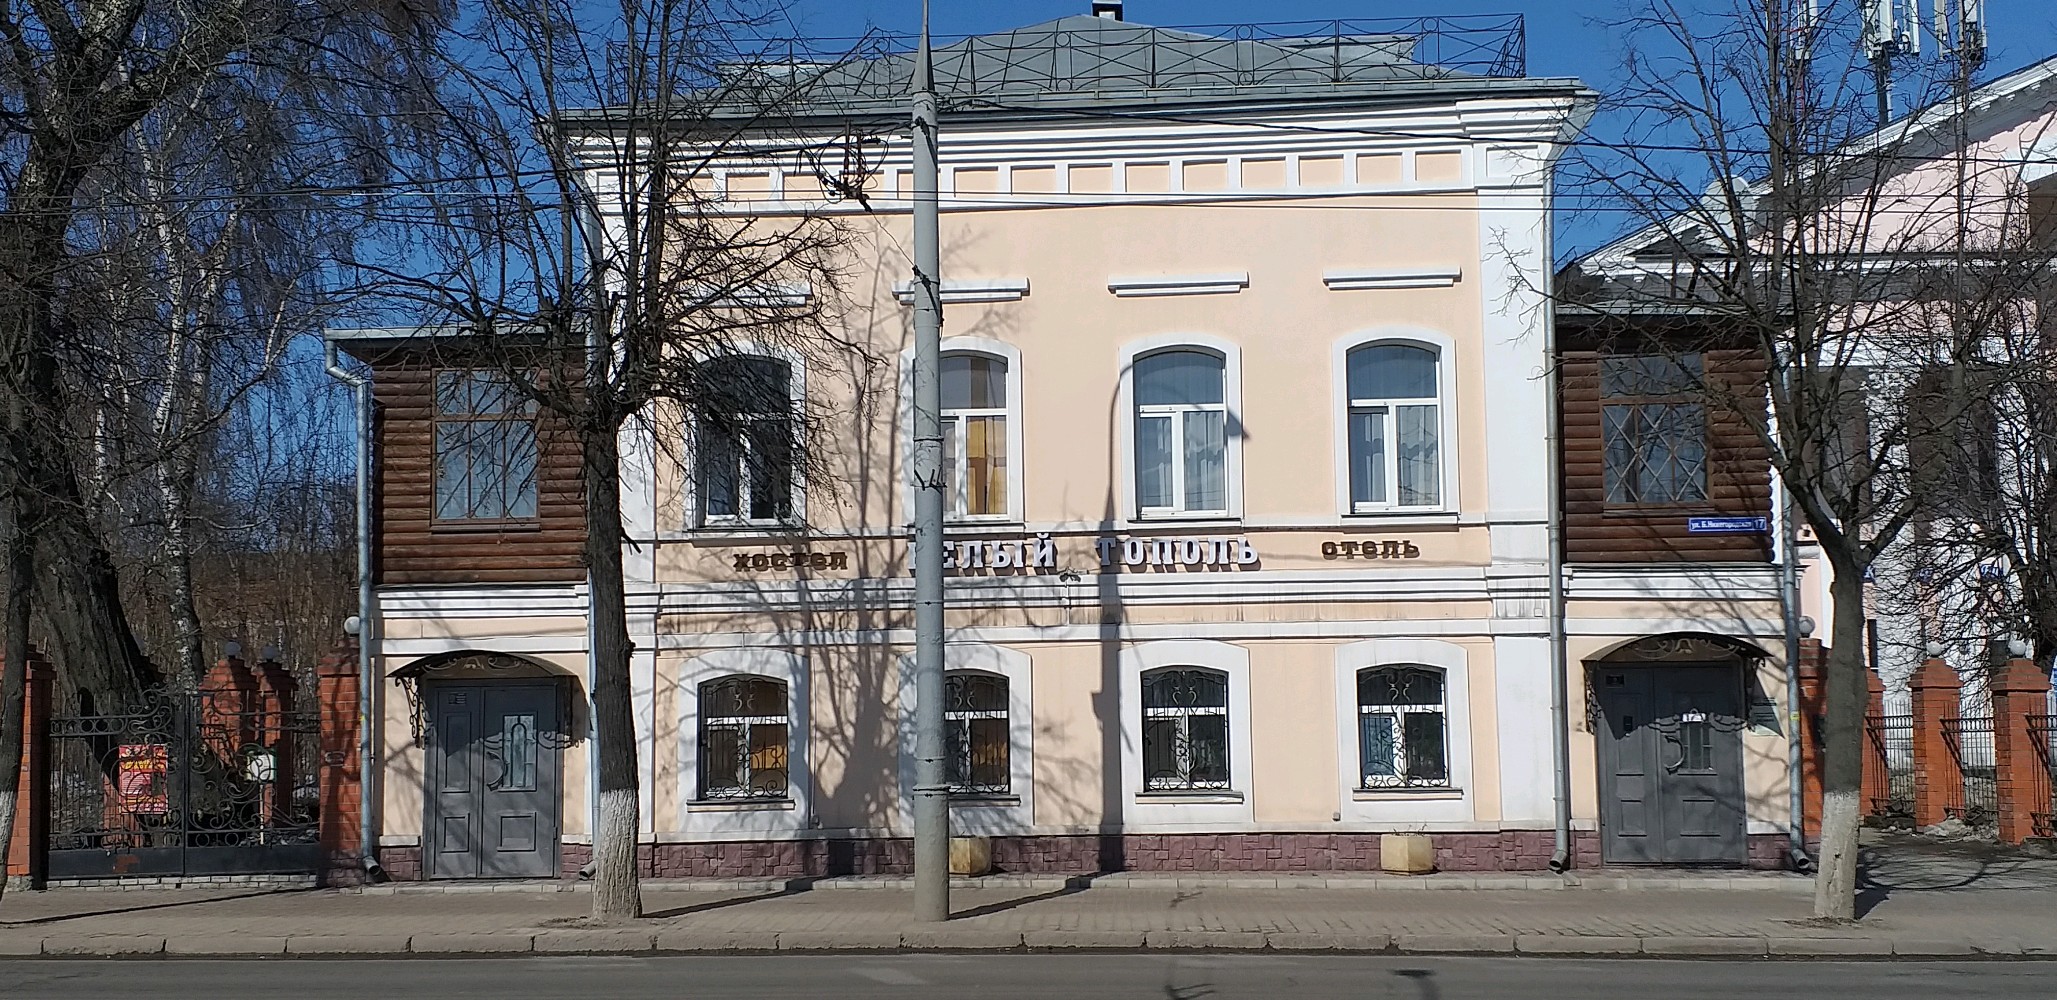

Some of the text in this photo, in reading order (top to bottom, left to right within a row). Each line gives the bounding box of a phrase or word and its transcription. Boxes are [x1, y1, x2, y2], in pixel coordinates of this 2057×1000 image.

[1754, 519, 1765, 528] 17
[1098, 537, 1259, 566] ТОПОЛЬ
[1321, 540, 1420, 560] отель
[733, 551, 848, 572] хостел
